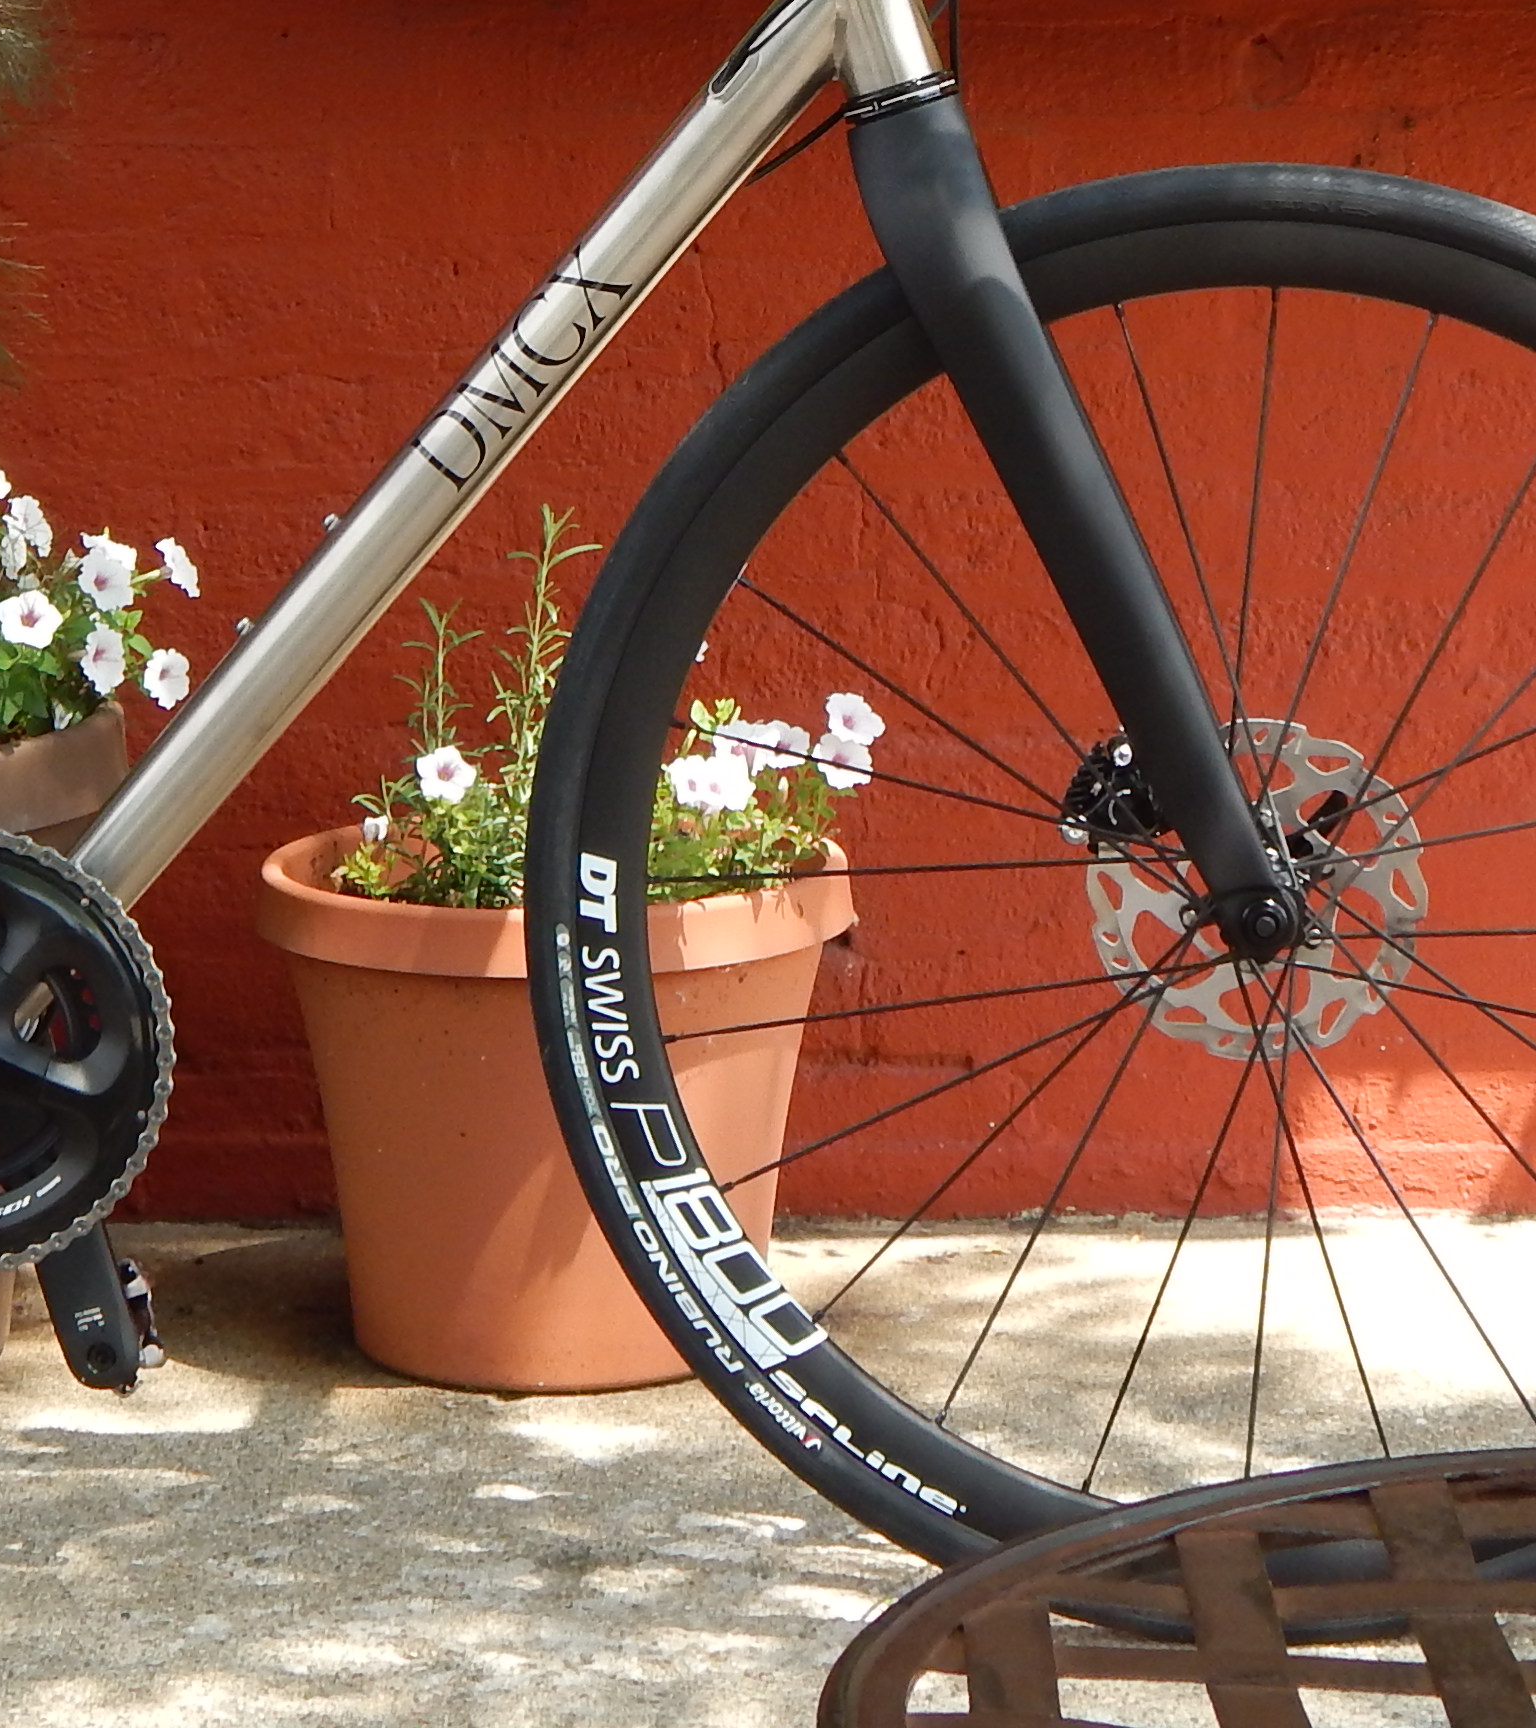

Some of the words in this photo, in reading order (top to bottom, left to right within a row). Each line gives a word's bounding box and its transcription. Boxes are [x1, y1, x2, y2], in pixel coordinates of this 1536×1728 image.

[411, 245, 634, 493] DMCX
[579, 852, 618, 933] DT
[581, 945, 640, 1084] SWISS
[591, 1124, 641, 1220] PRO
[609, 1101, 829, 1357] P1800
[632, 1220, 745, 1373] RUBINO
